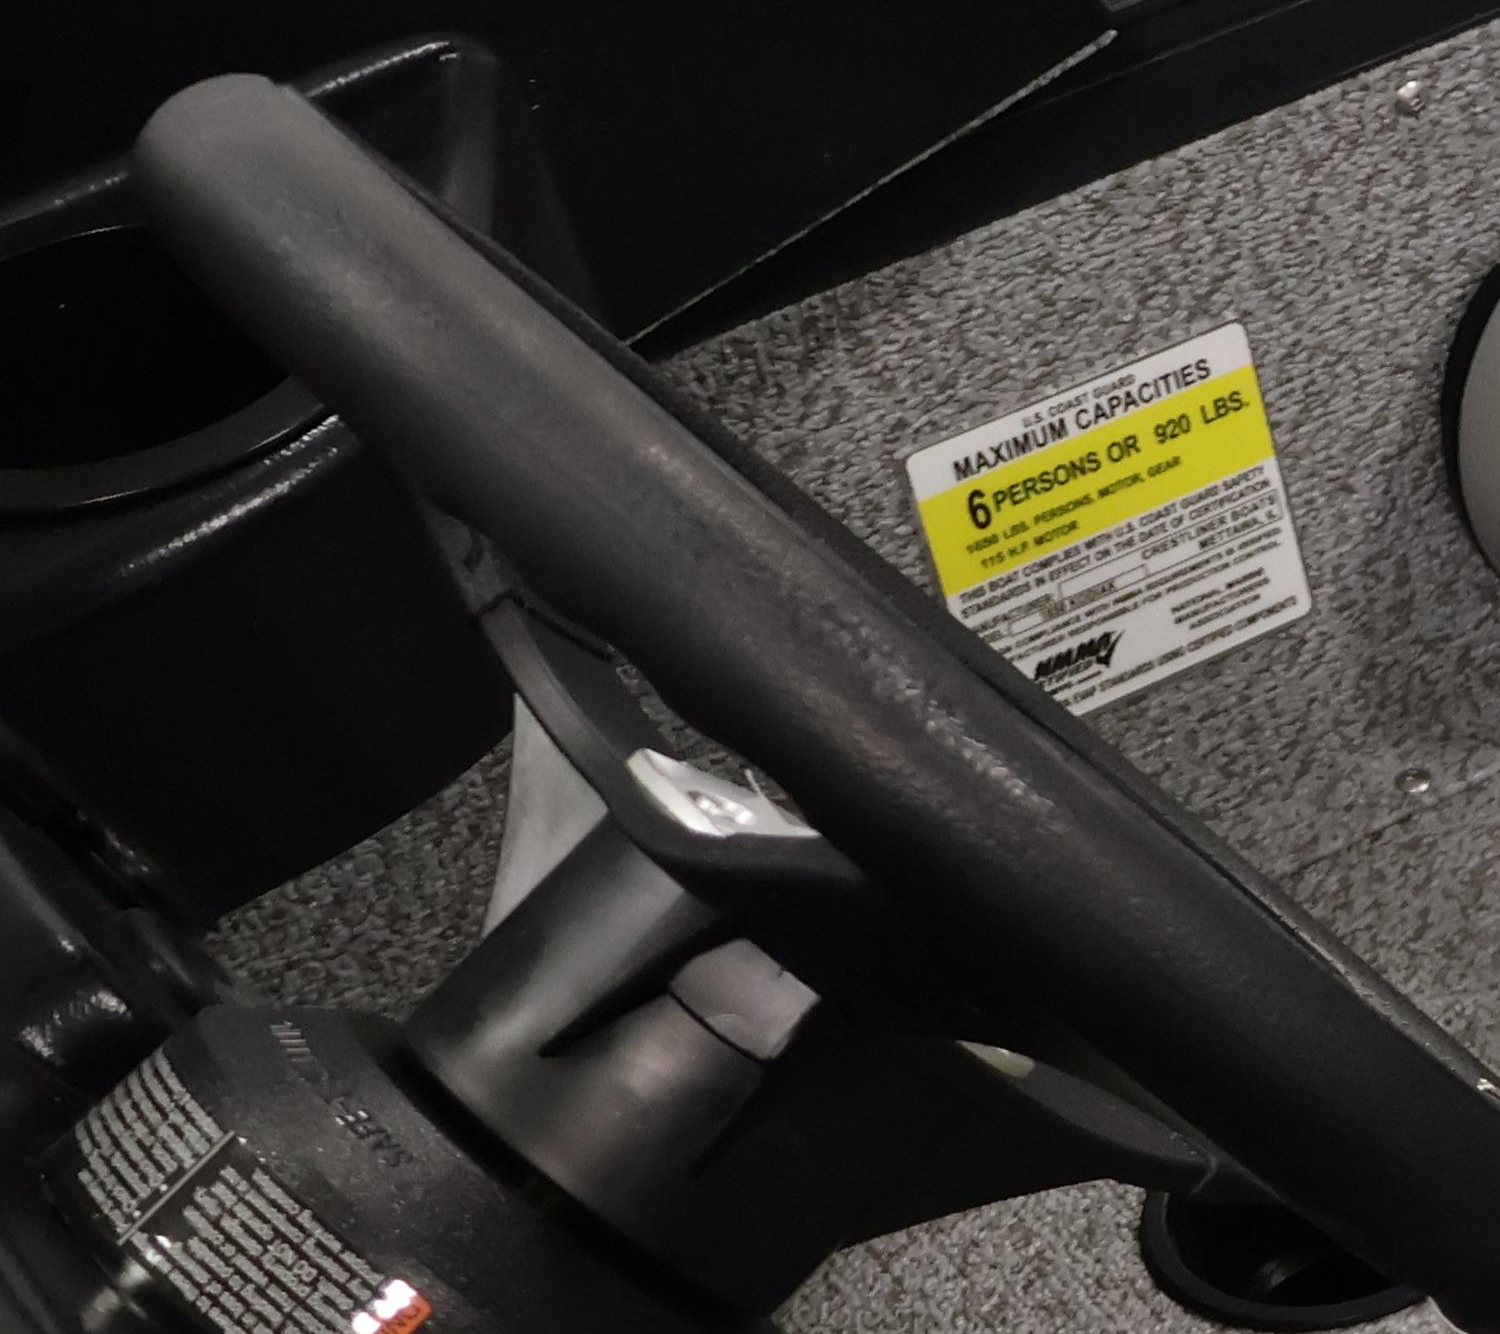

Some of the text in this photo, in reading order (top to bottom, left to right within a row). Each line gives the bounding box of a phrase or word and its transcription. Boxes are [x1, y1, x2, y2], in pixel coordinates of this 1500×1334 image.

[954, 357, 1211, 482] MAXIMUM CAPACITIES
[965, 387, 1249, 531] 6 PERSONS OR 920 LBS.
